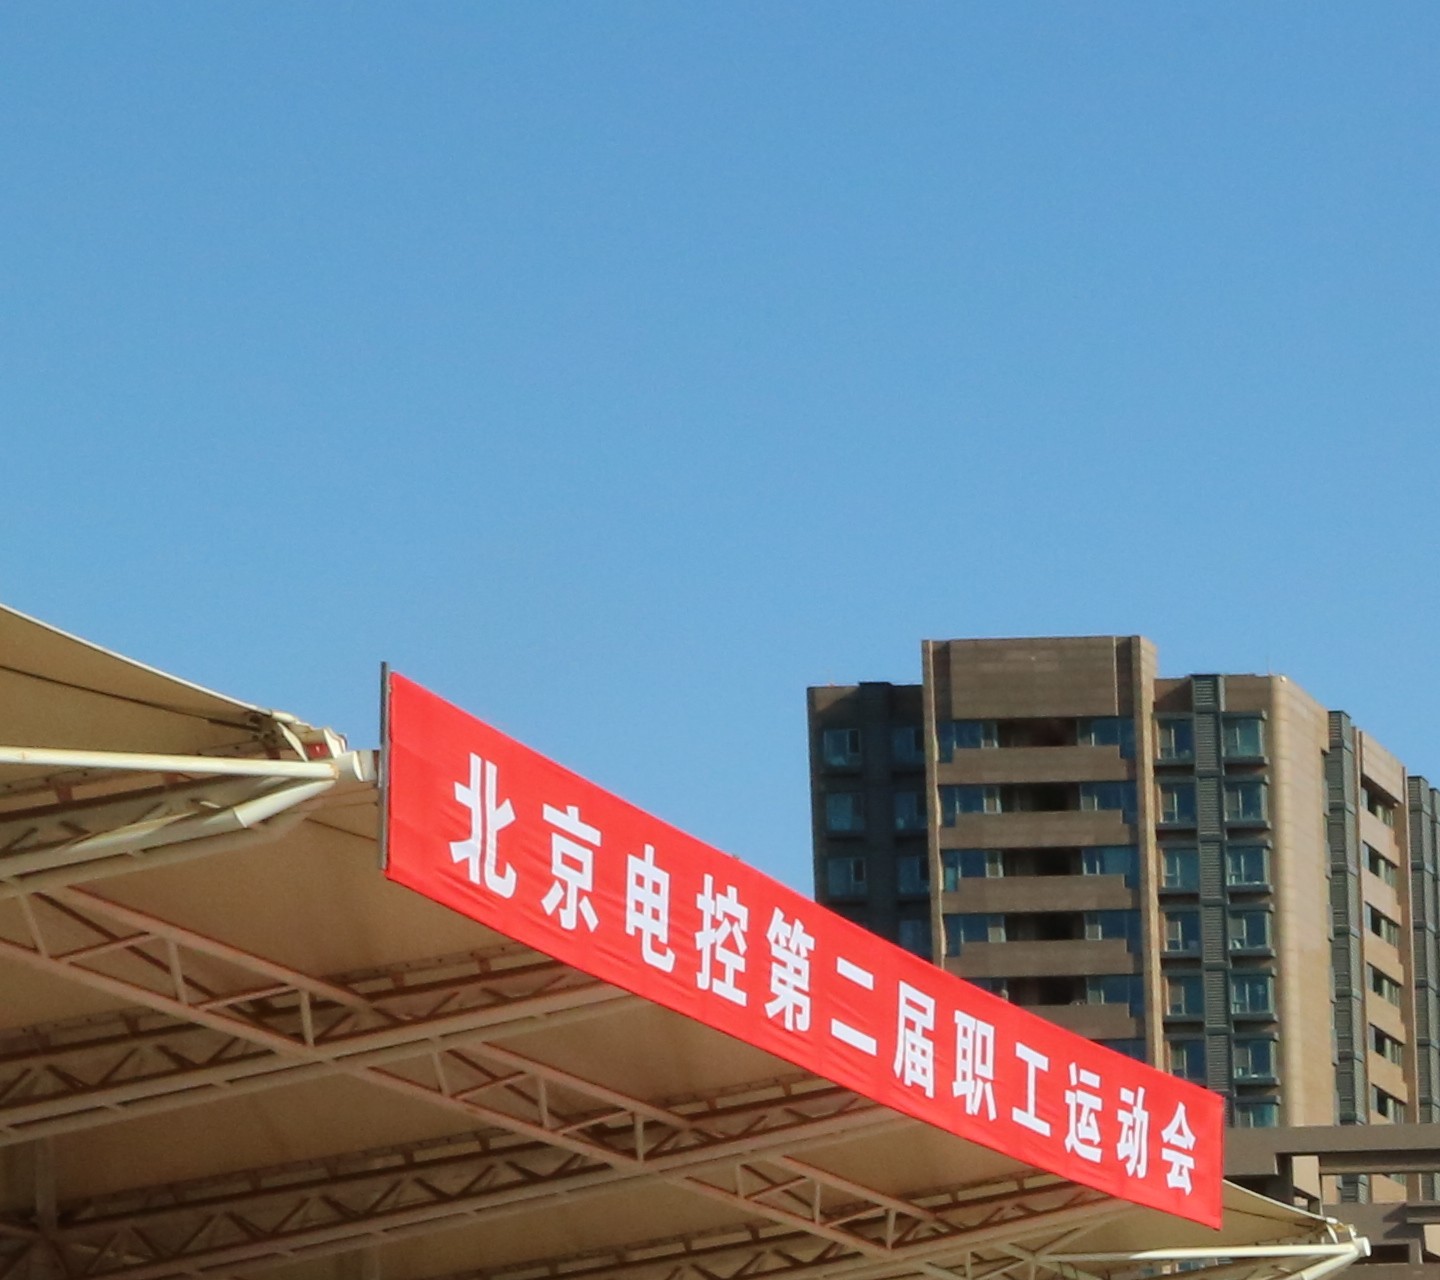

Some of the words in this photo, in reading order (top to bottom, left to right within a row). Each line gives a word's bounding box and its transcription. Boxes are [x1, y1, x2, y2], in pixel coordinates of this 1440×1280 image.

[450, 752, 1197, 1196] 北京电控第二届职工运动会
